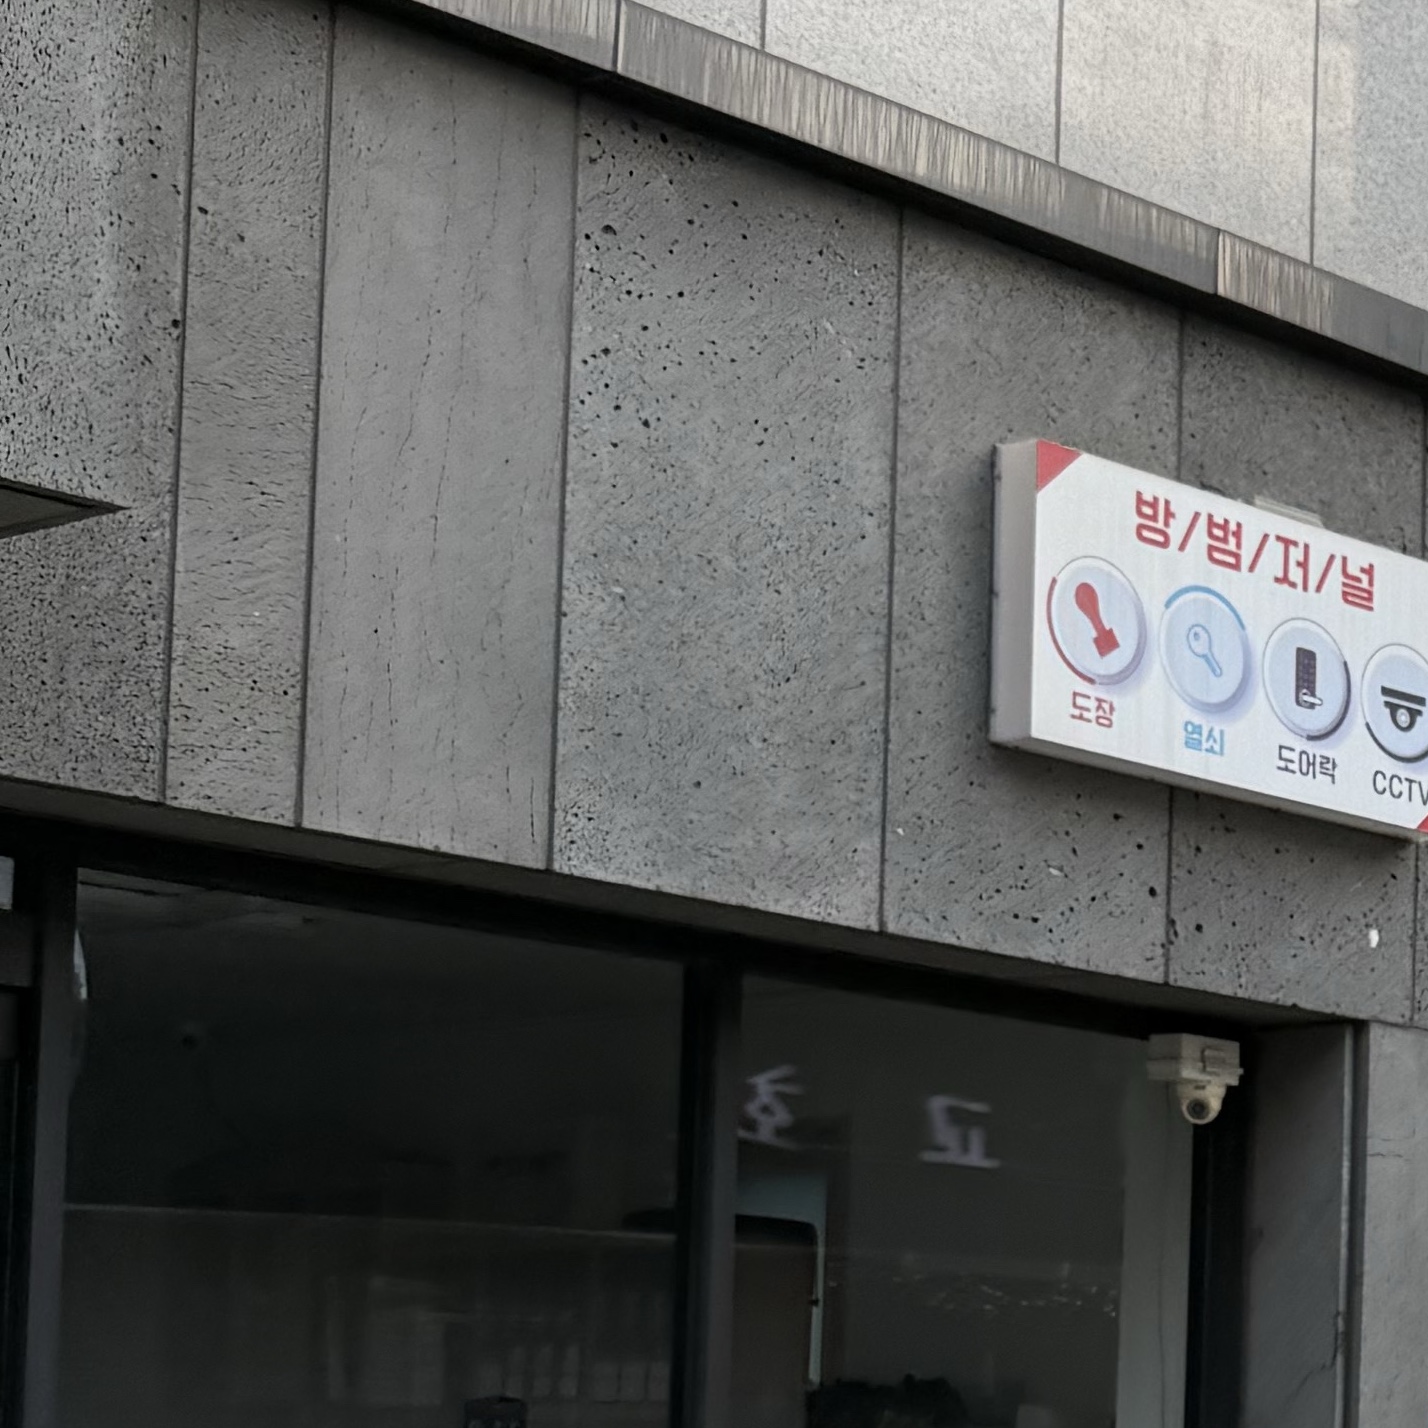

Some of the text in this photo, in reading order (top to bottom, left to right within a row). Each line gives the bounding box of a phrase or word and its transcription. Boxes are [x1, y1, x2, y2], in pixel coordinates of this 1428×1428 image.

[1135, 490, 1374, 612] 방/범/저/널
[1070, 690, 1115, 728] 도장
[1184, 720, 1224, 756] 열쇠
[1276, 744, 1338, 784] 도어락
